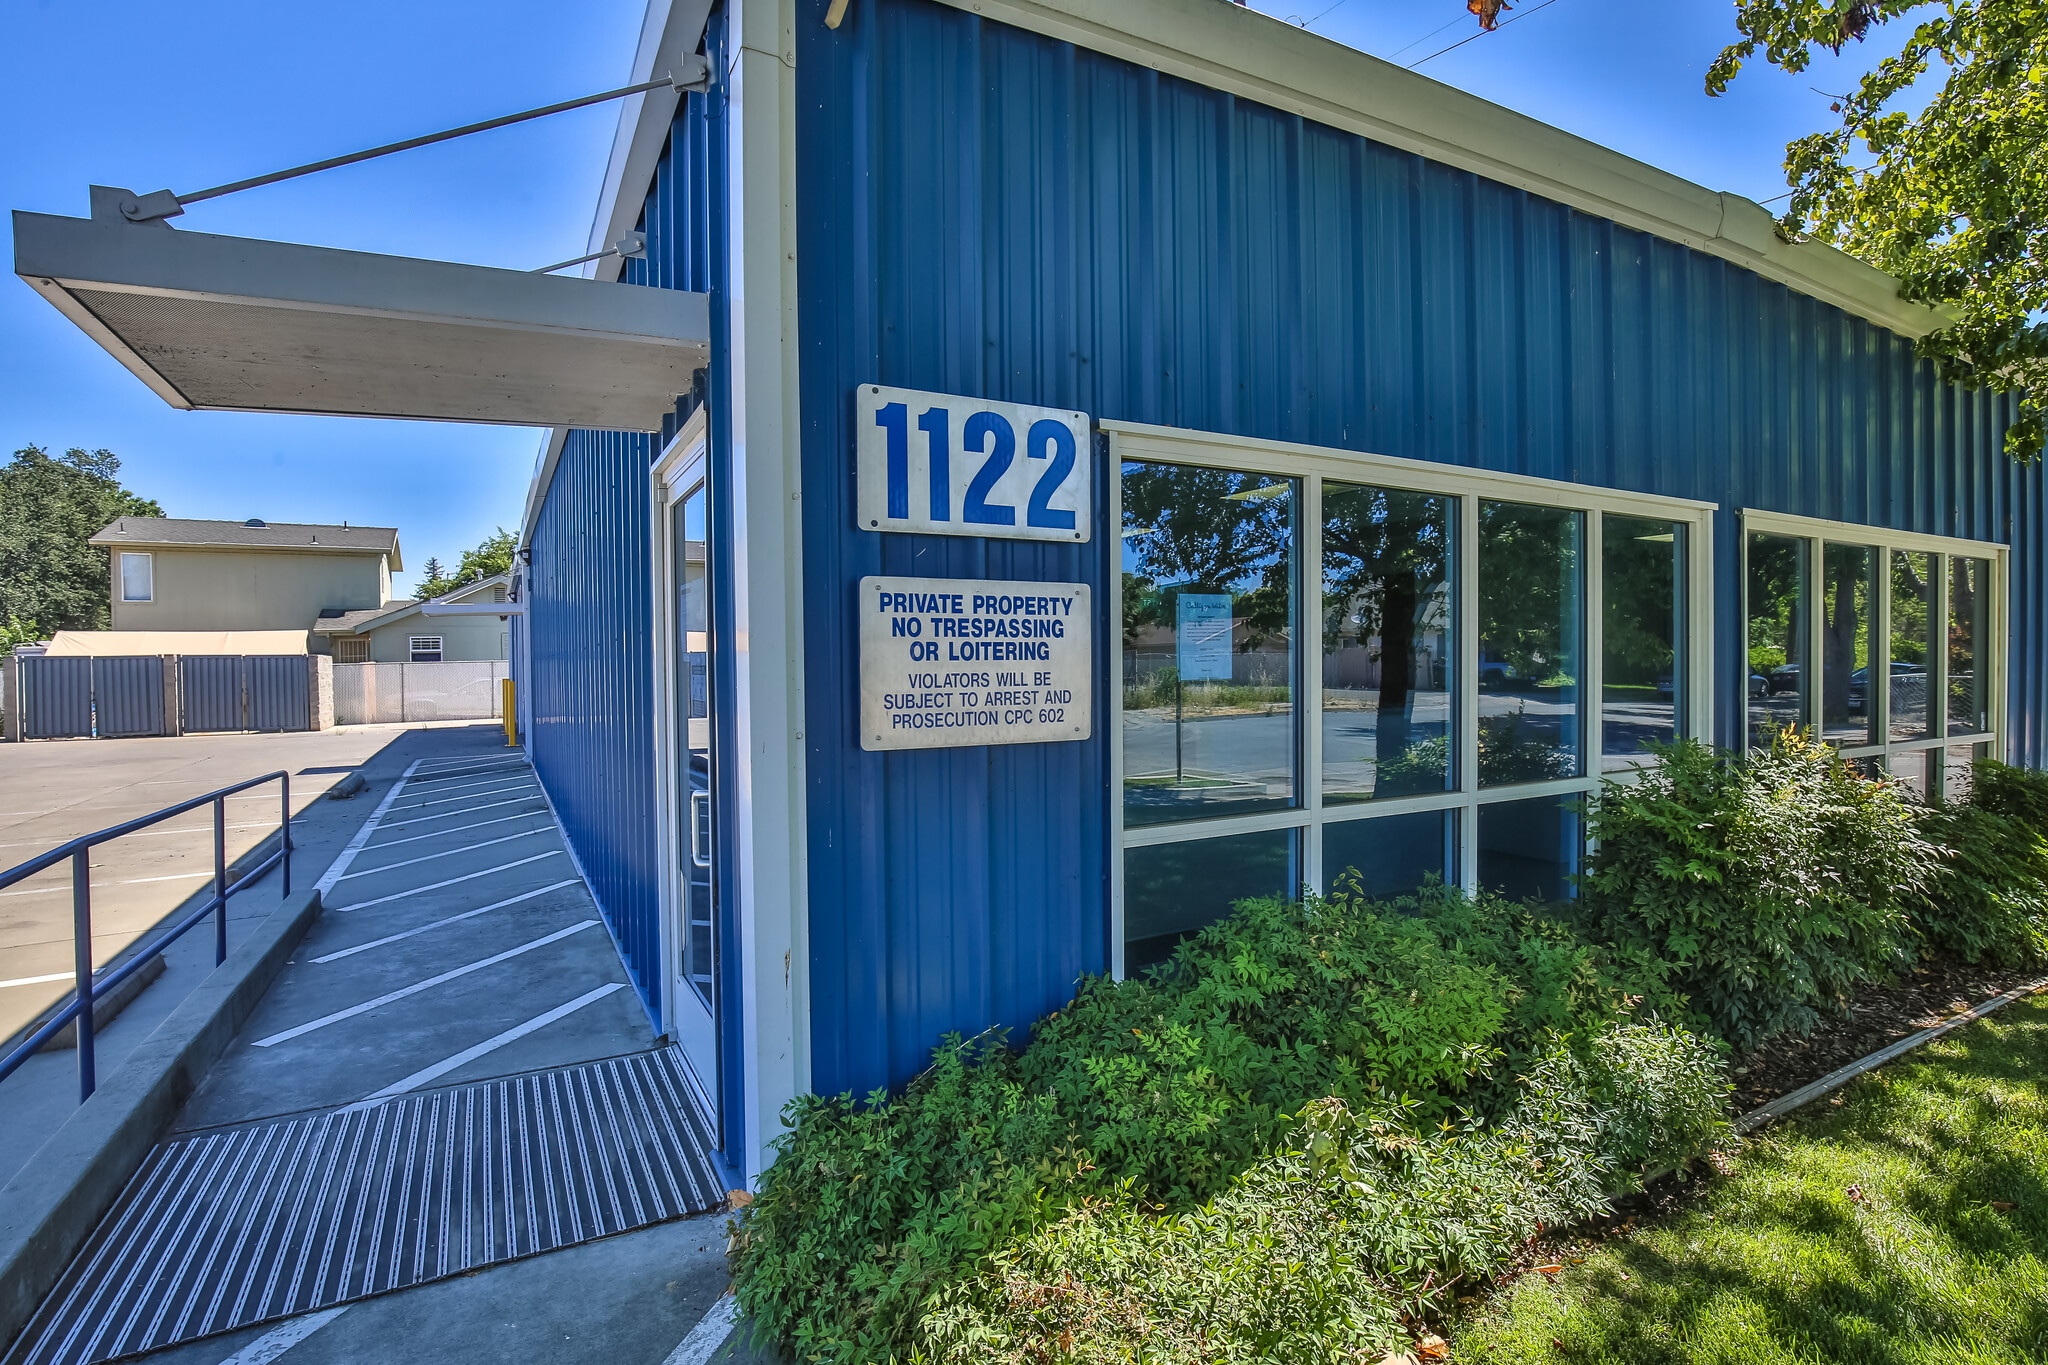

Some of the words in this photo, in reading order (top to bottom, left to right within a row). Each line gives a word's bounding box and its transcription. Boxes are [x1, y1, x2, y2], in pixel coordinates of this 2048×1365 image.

[875, 402, 1076, 530] 1122
[879, 592, 963, 613] PRIVATE
[973, 595, 1073, 616] PROPERTY
[892, 617, 922, 637] NO
[931, 618, 1064, 638] TRESPASSING
[909, 641, 939, 662] OR
[949, 641, 1050, 661] LOITERING
[908, 672, 990, 689] VIOLATORS
[996, 672, 1028, 687] WILL
[1034, 672, 1052, 687] BE
[883, 693, 954, 710] SUBJECT
[959, 692, 979, 707] TO
[984, 690, 1039, 707] ARREST
[1044, 689, 1072, 704] AND
[892, 710, 998, 730] PROSECUTION
[1004, 709, 1033, 725] CPC
[1039, 708, 1065, 724] 602
